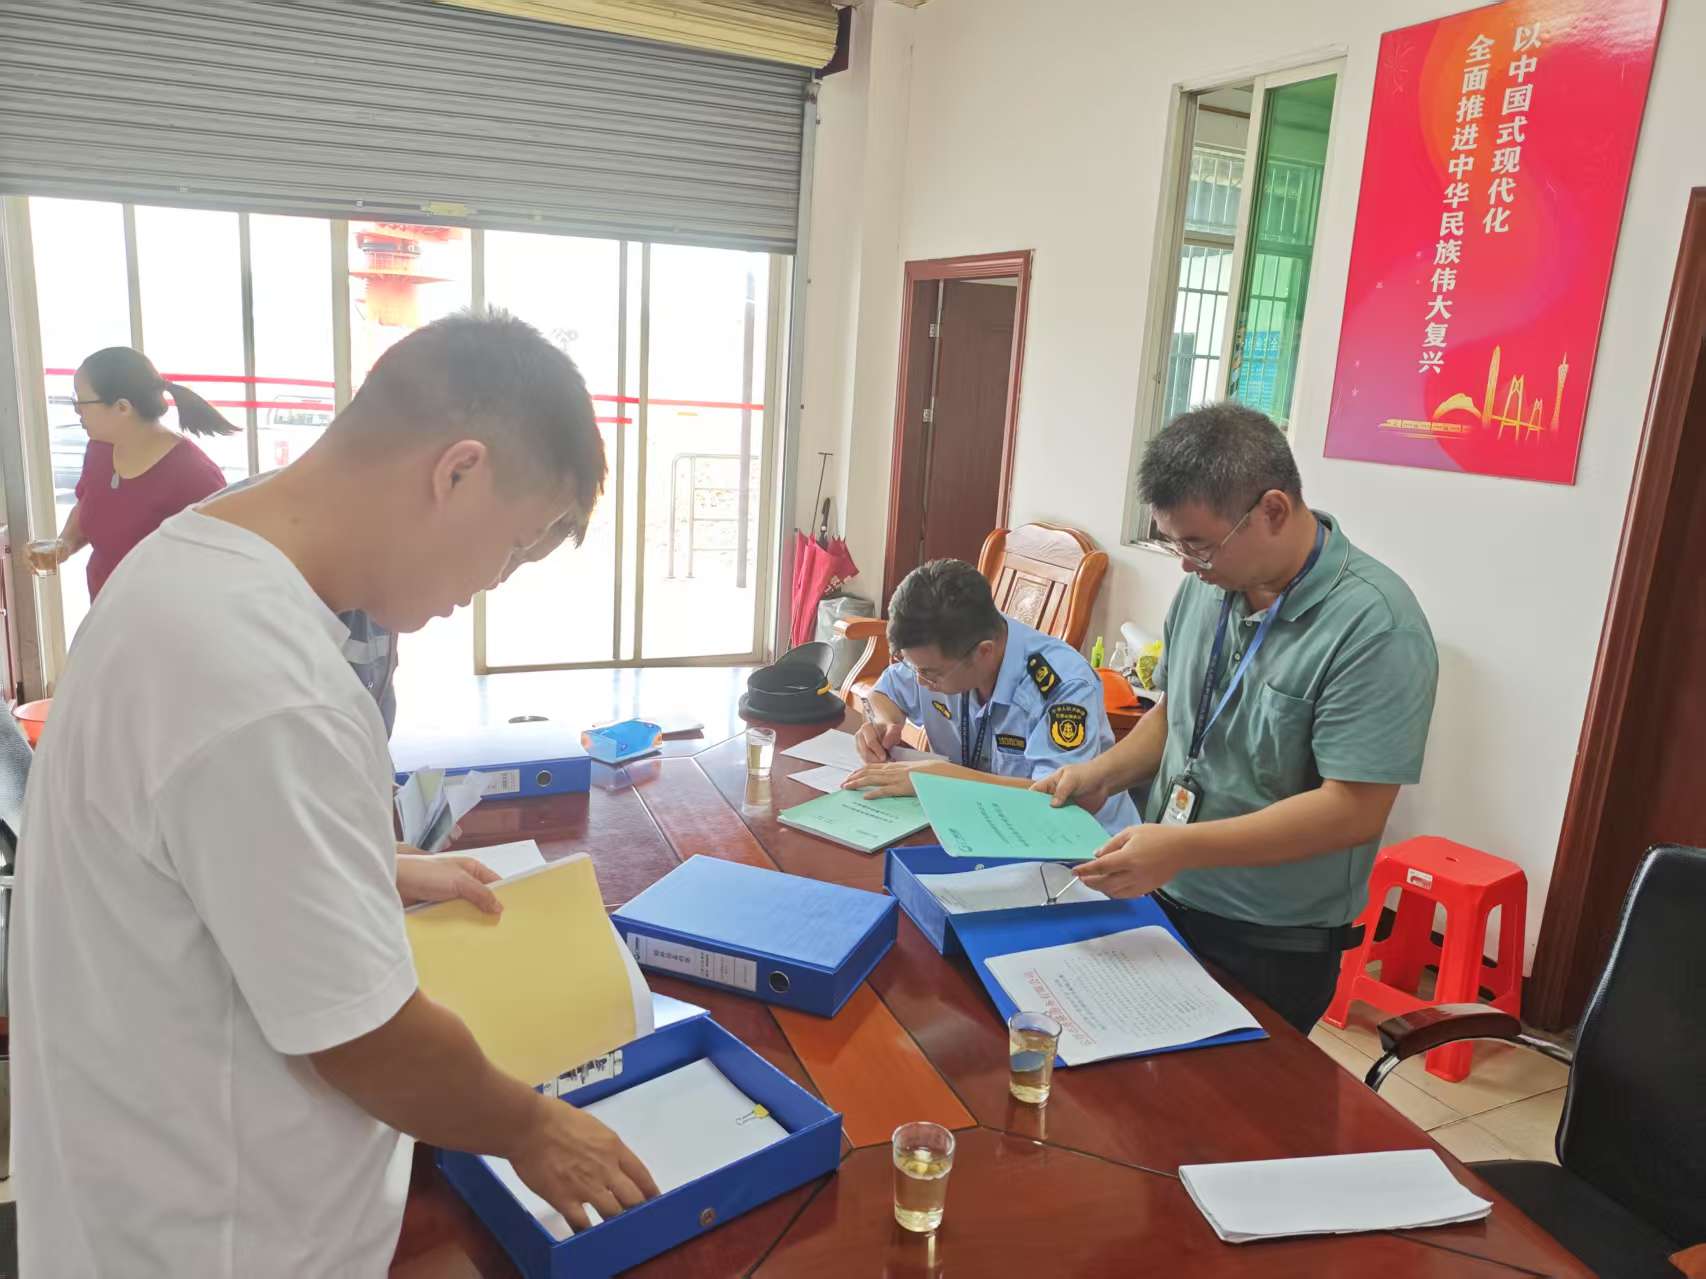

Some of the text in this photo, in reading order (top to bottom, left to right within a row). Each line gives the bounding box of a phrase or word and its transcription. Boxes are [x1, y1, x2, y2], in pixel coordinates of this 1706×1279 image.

[1418, 33, 1495, 375] 全面推进中华民族伟大复兴
[1483, 22, 1542, 235] 以中国式现代化
